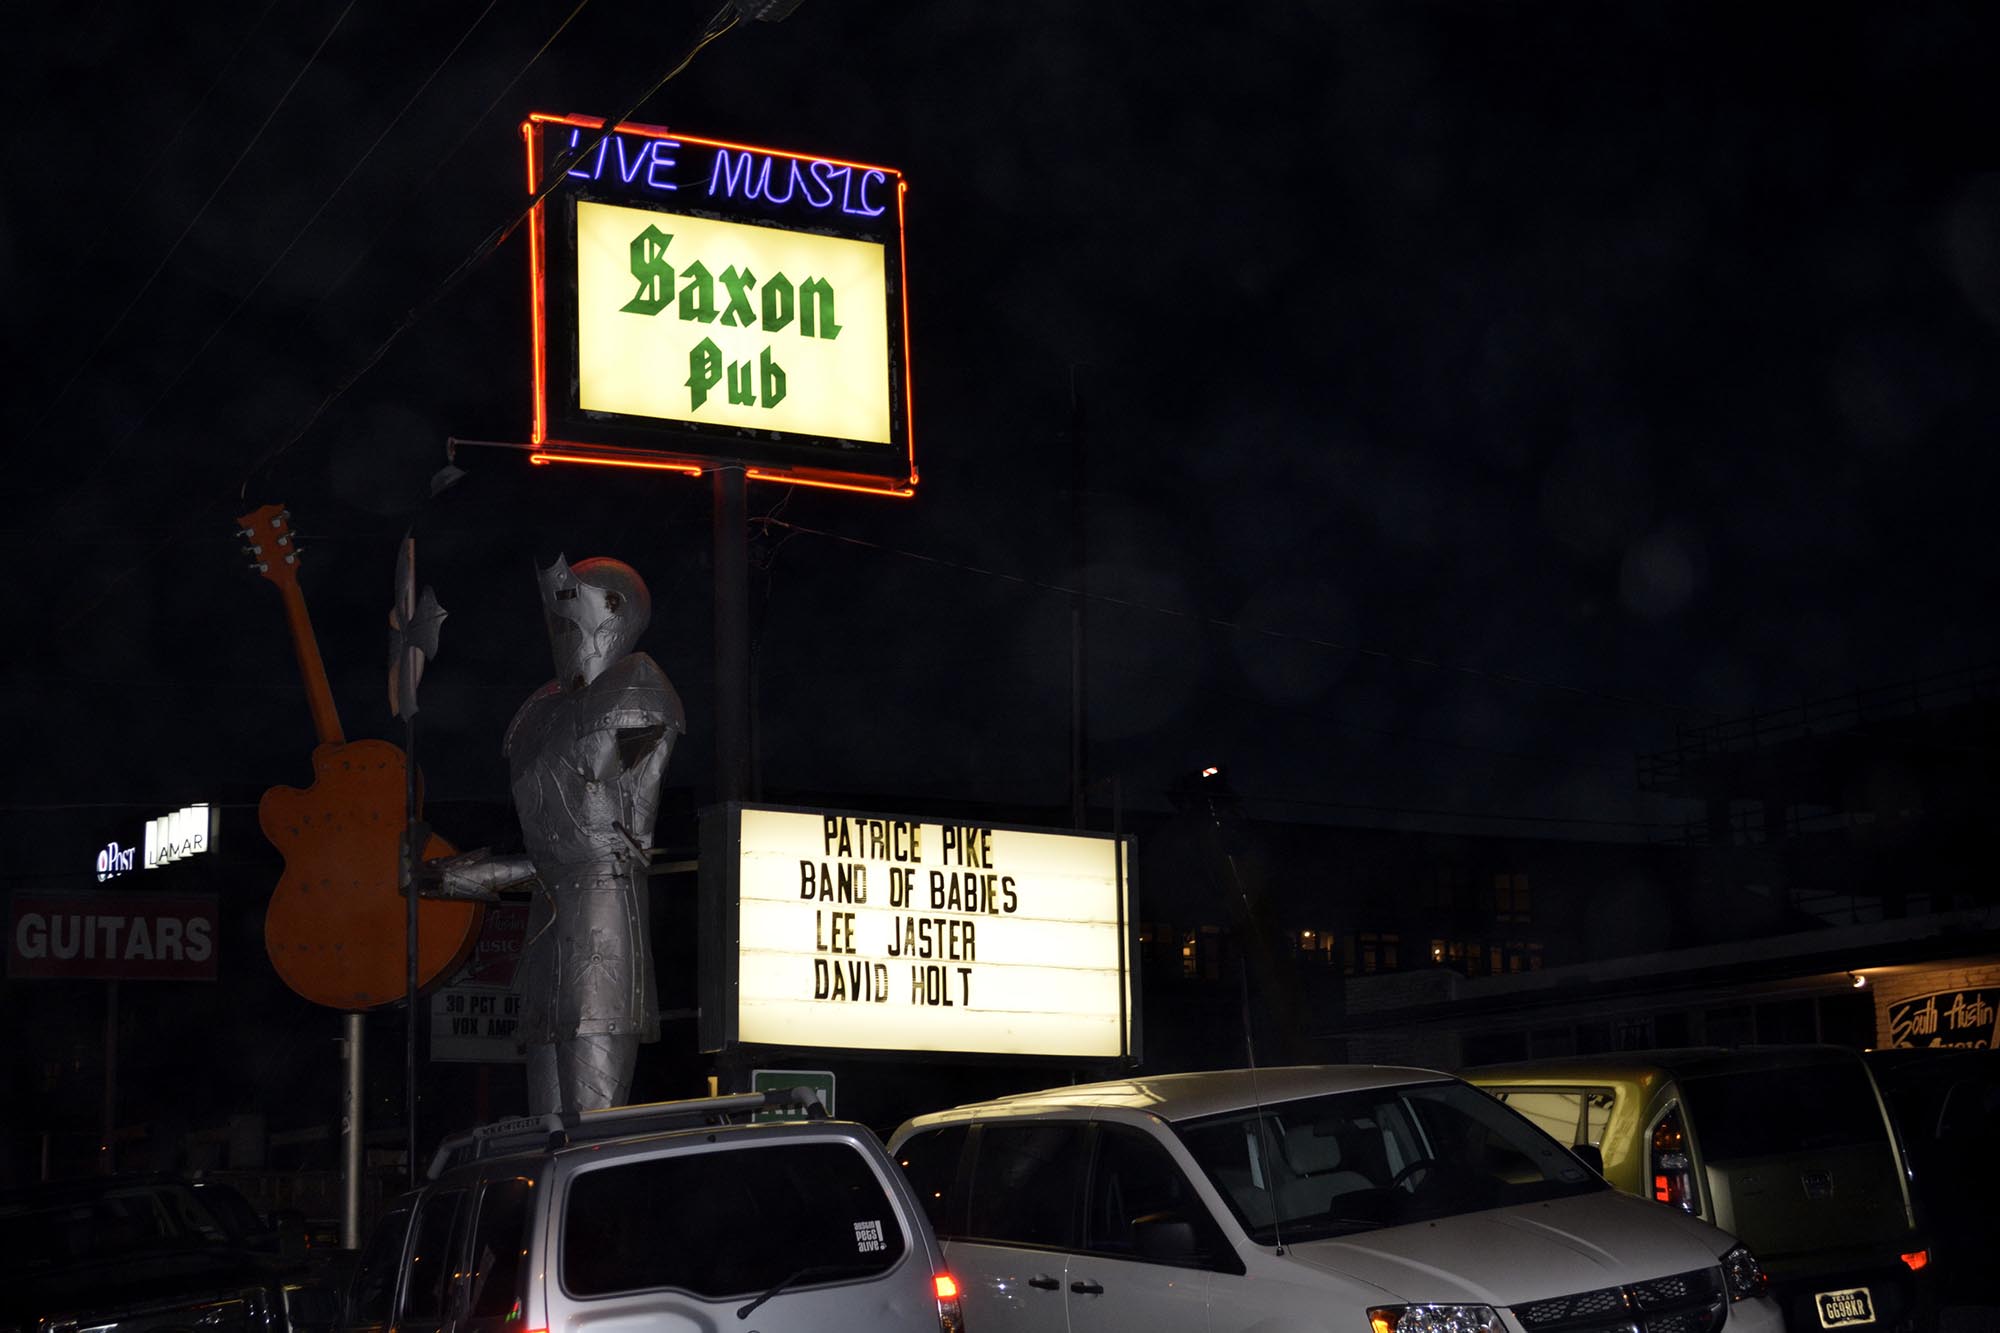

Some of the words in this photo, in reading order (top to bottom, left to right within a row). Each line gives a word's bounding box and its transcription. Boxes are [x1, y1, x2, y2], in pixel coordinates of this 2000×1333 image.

[567, 128, 681, 191] LIVE
[709, 149, 887, 217] MUSIC
[619, 223, 843, 340] Saxon
[684, 336, 787, 413] Pub
[149, 834, 204, 866] LAMAR
[824, 815, 921, 863] PATRICE
[942, 825, 993, 868] PIKE
[799, 860, 867, 904] BAND
[889, 867, 915, 908] OF
[929, 870, 1018, 915] BABIES
[16, 912, 212, 962] GUITARS
[816, 910, 856, 954] LEE
[887, 916, 976, 961] JASTER
[446, 994, 465, 1013] 30
[470, 996, 496, 1014] PCT
[814, 958, 888, 1003] DAVID
[911, 965, 972, 1007] HOLT
[452, 1017, 478, 1035] VOX
[487, 1018, 518, 1037] AMP
[1890, 995, 1938, 1048] South
[1943, 993, 1993, 1031] Austin
